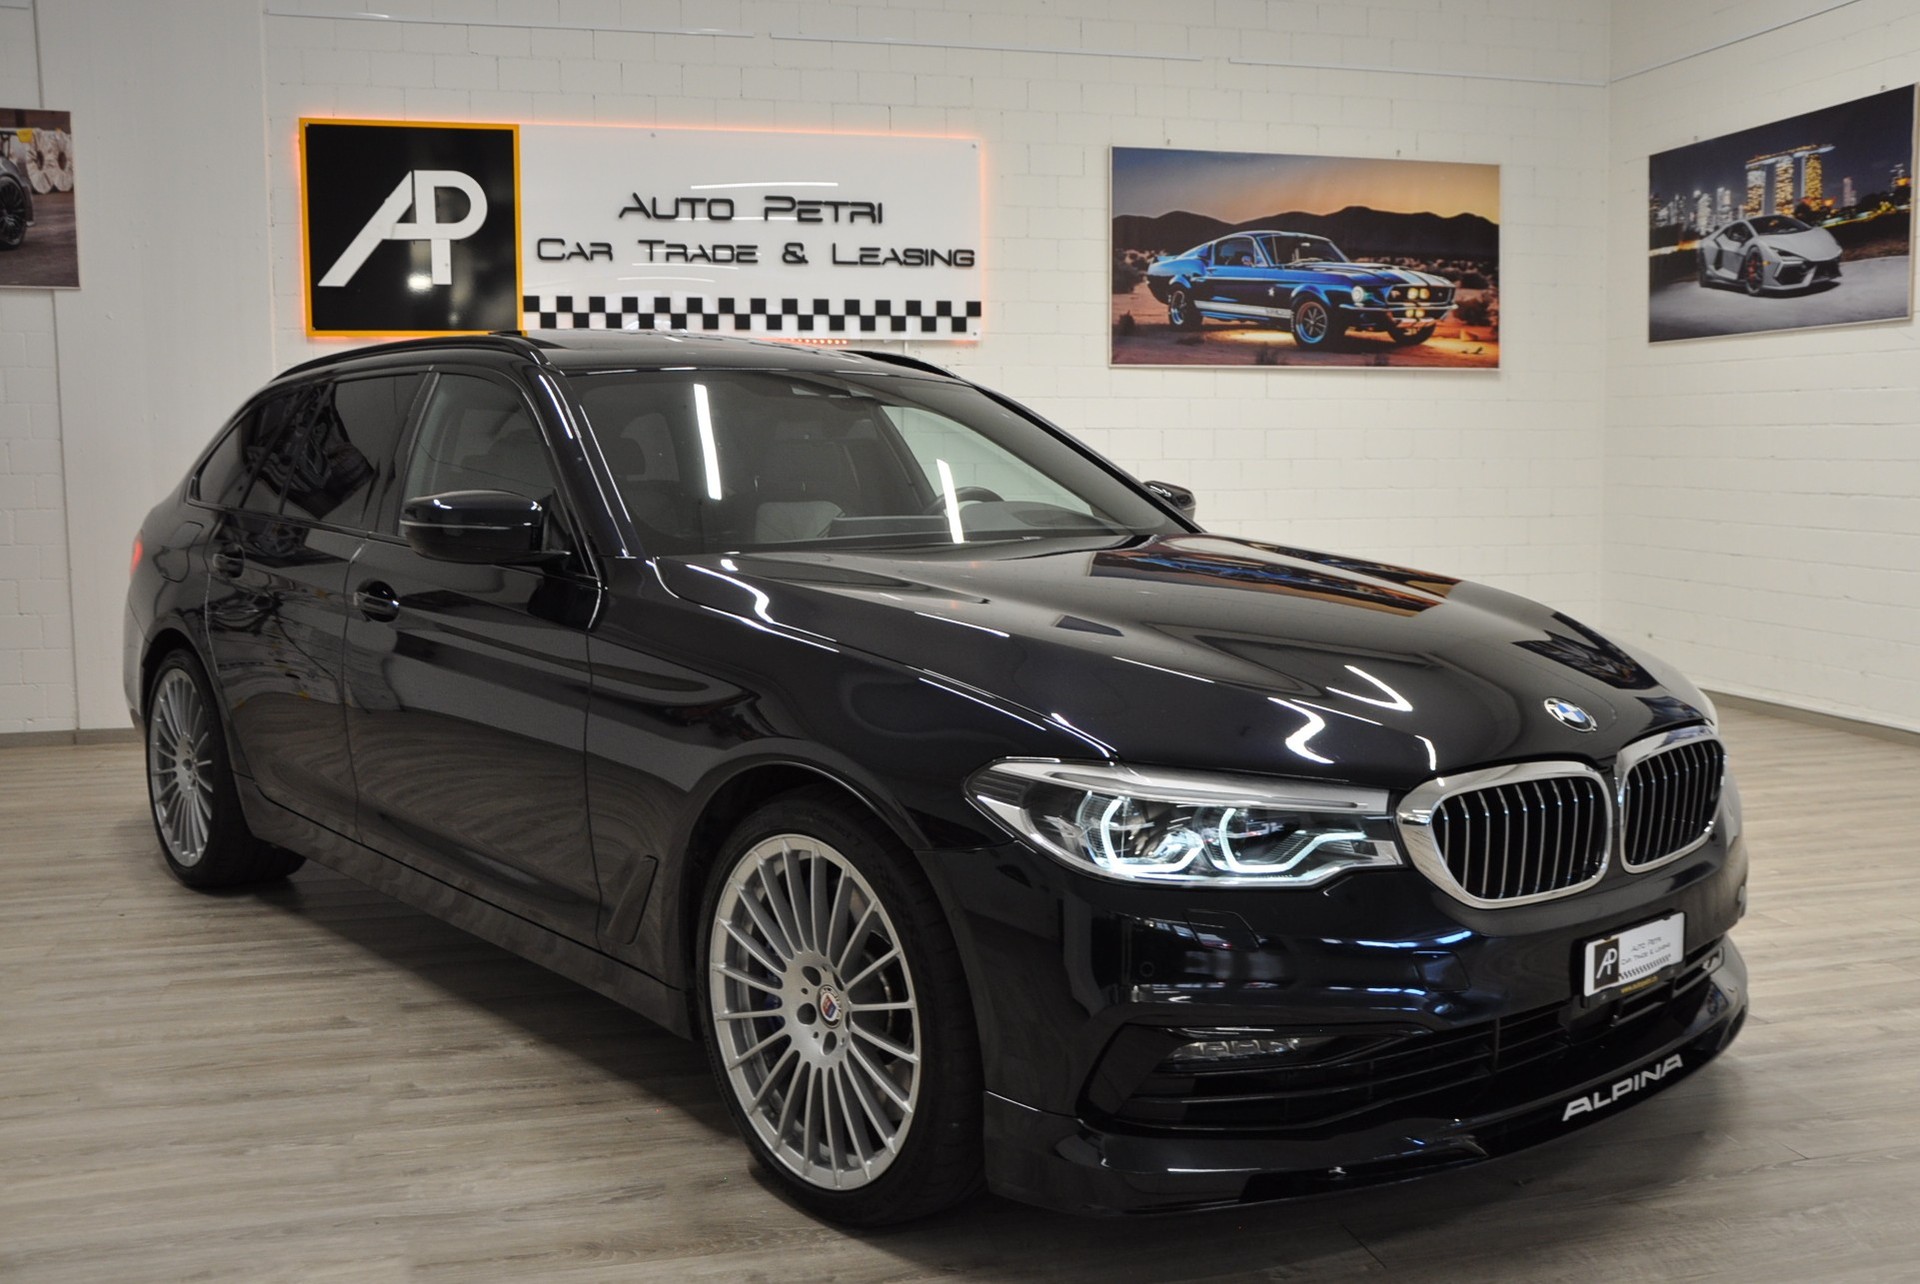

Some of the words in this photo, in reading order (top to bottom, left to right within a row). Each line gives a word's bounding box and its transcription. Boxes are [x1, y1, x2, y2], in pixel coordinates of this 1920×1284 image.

[317, 169, 488, 287] AP
[618, 192, 735, 222] AUTO
[763, 195, 884, 225] PETRI
[536, 237, 615, 263] CAR
[637, 239, 759, 265] TRADE
[781, 242, 809, 265] &
[832, 242, 975, 268] LEASING
[1562, 1053, 1684, 1122] ALPINA
